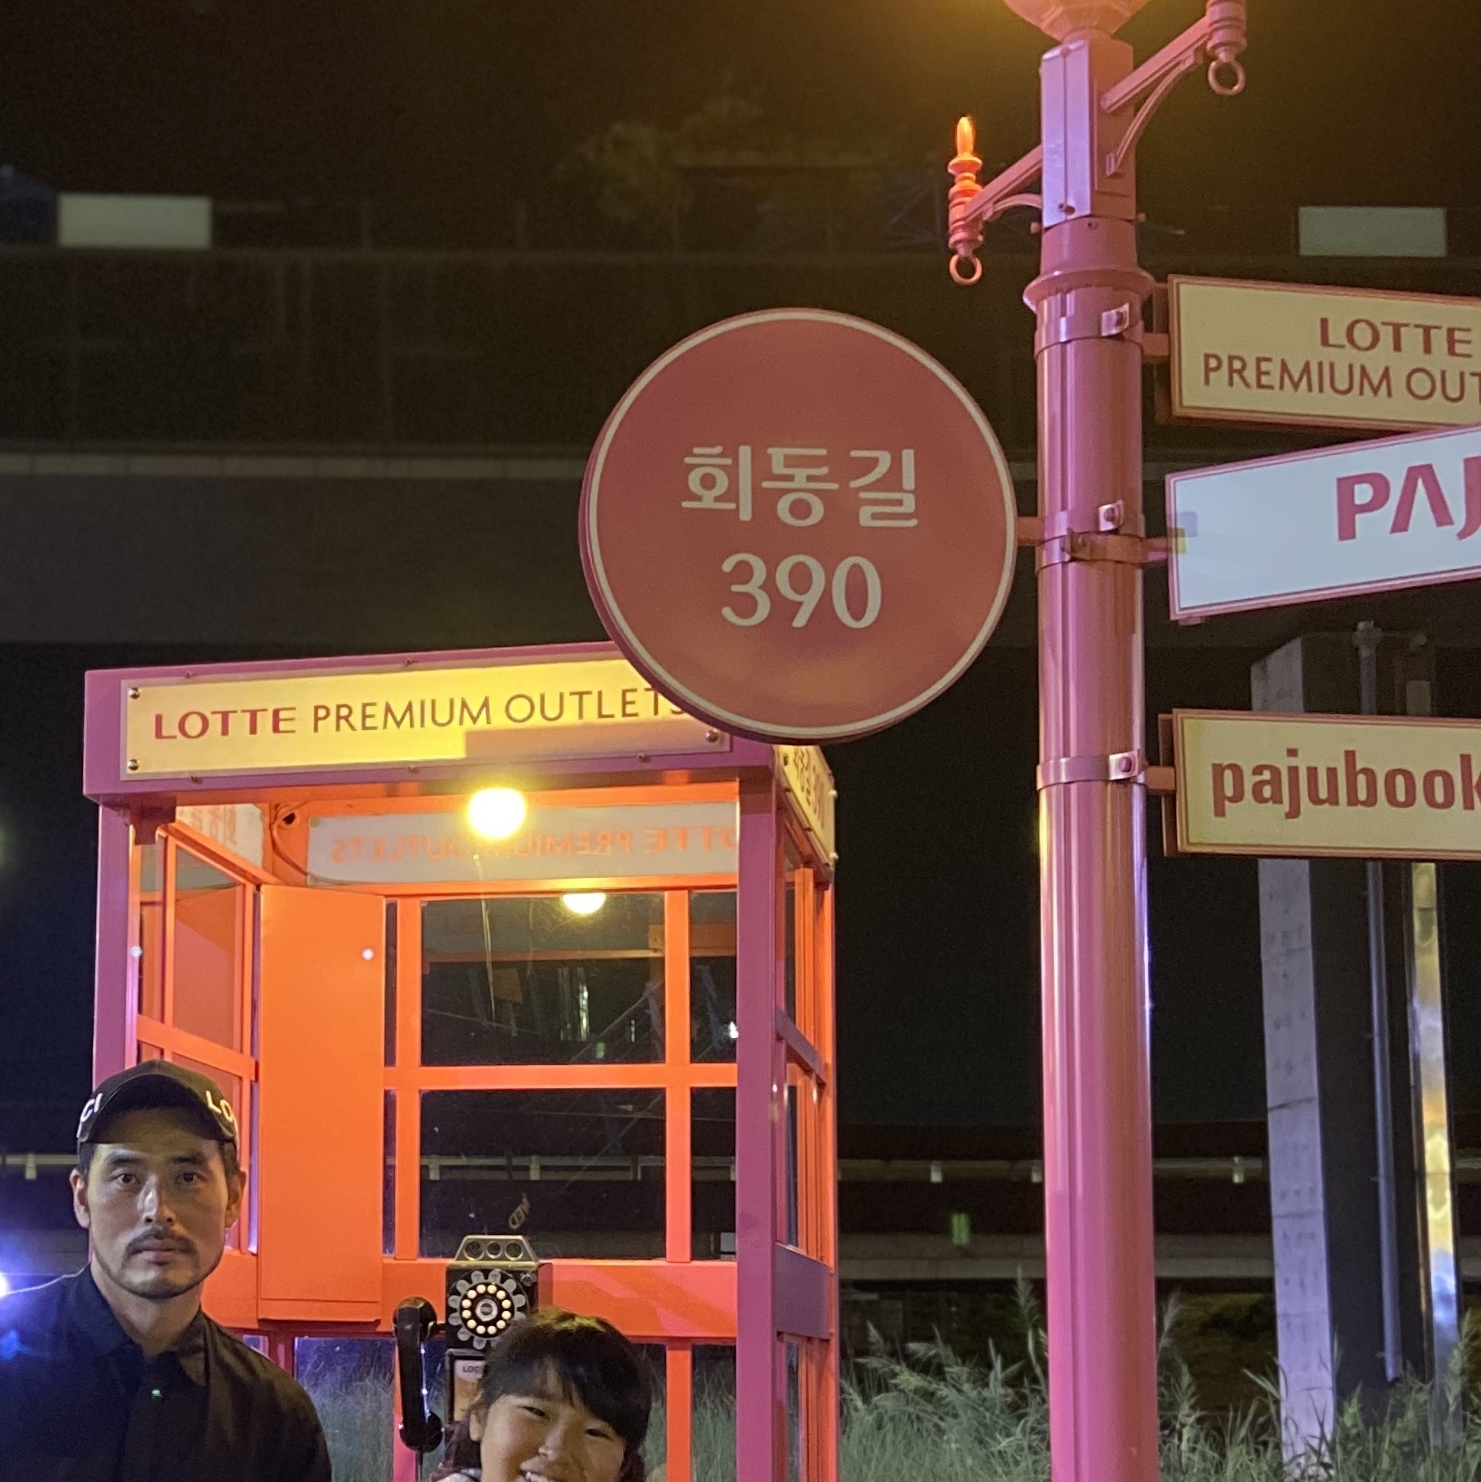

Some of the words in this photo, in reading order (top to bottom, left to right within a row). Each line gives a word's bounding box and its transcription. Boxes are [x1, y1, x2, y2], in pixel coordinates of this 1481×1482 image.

[1320, 316, 1472, 358] LOTTE
[1203, 352, 1393, 398] PREMIUM
[681, 444, 919, 528] 회동길
[720, 552, 883, 629] 390
[154, 706, 297, 740] LOTTE
[313, 696, 492, 733] PREMIUM
